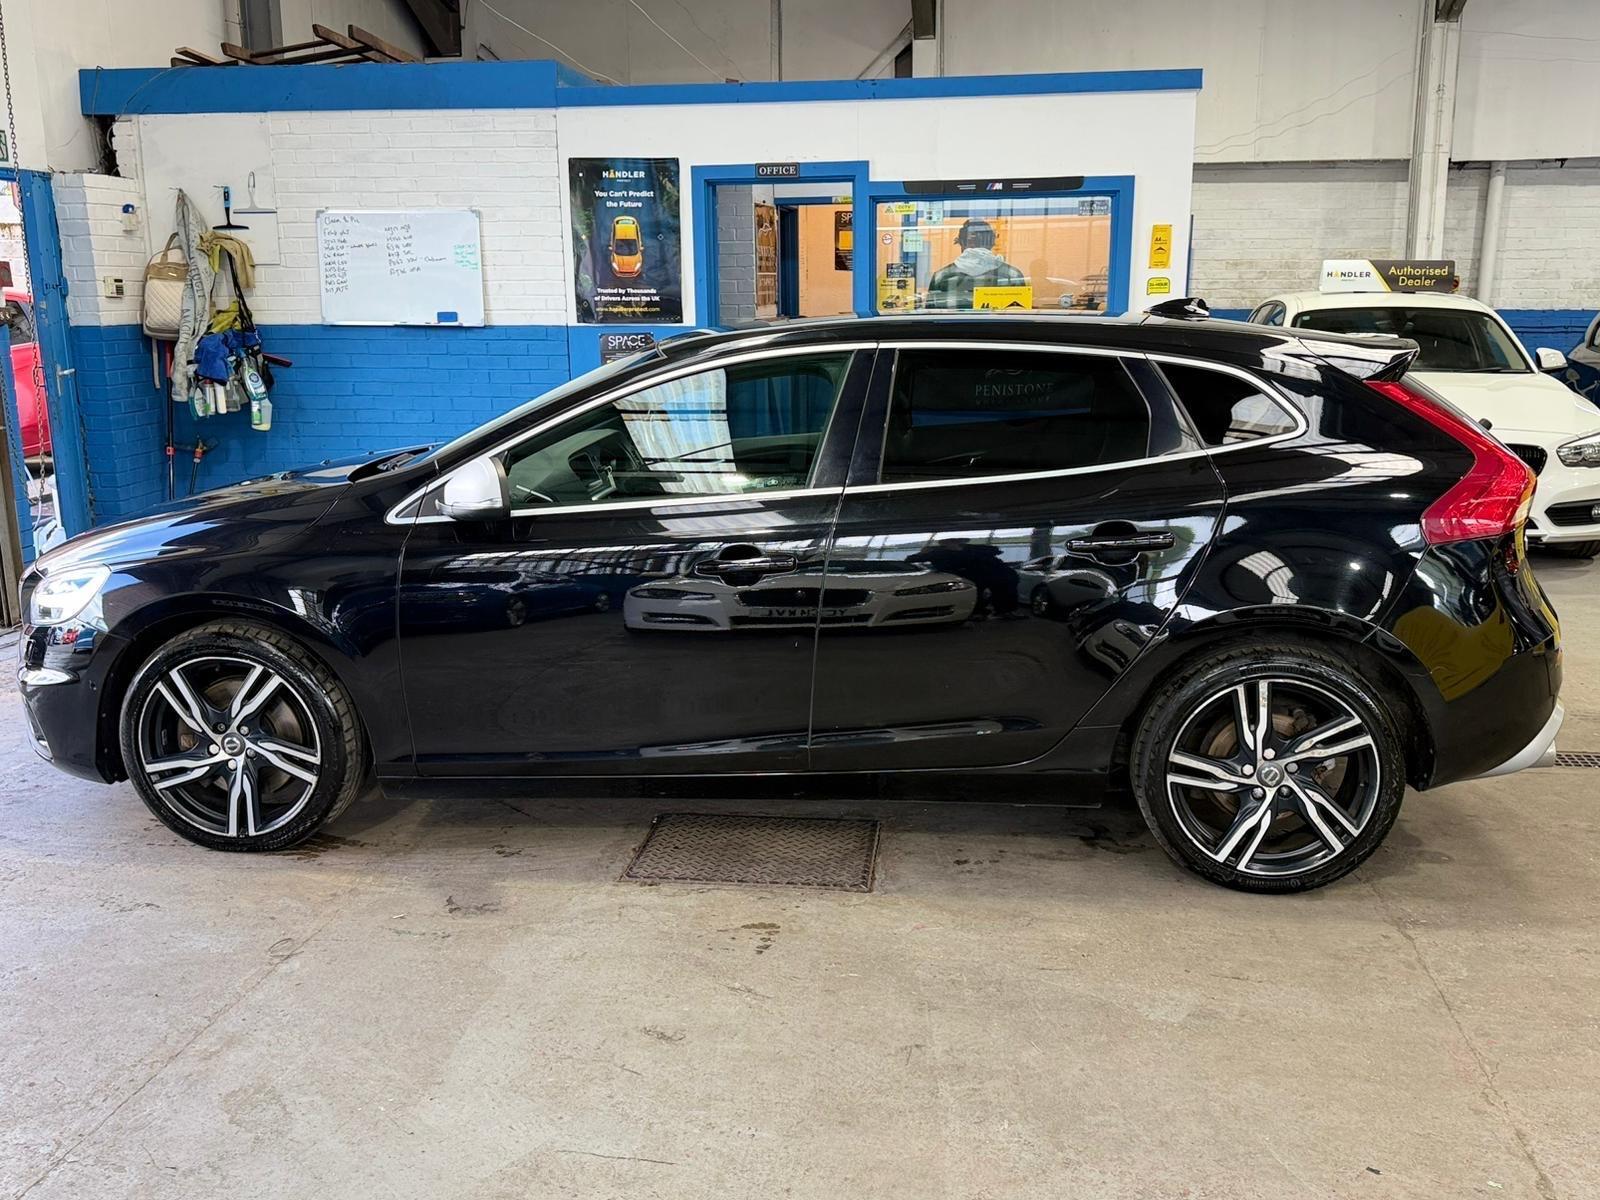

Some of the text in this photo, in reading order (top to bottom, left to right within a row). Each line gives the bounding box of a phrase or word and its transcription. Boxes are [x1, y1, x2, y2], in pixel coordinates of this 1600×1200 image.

[758, 165, 797, 176] OFFICE
[609, 190, 628, 198] Can't
[629, 190, 654, 198] Predict
[606, 200, 643, 208] the Future
[1388, 265, 1449, 276] Authorised
[1399, 276, 1436, 286] Dealer
[618, 287, 626, 295] by
[608, 334, 646, 347] SPACE
[975, 383, 1055, 396] PENISTONE
